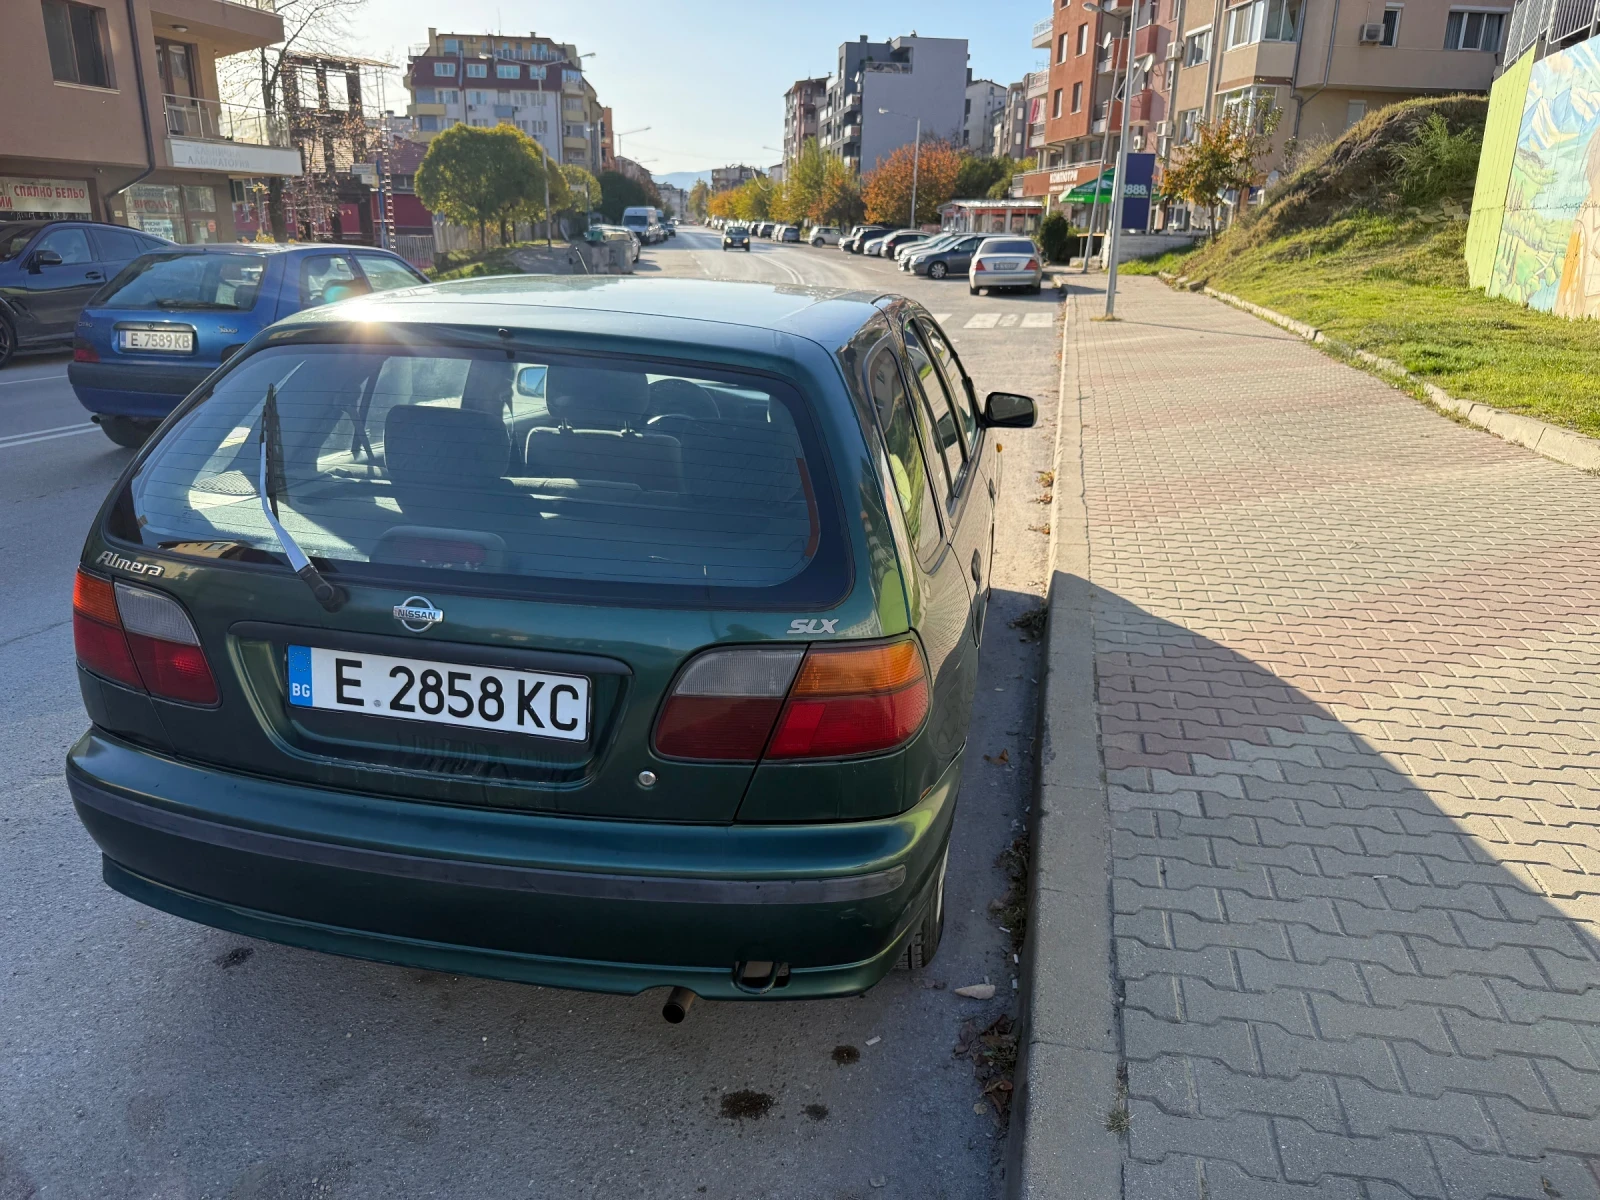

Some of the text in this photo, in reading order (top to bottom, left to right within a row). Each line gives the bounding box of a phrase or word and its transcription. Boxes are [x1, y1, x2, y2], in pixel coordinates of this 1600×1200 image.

[14, 185, 85, 199] СПАЛНО БЕЛЬО
[95, 550, 165, 577] Almera
[397, 609, 436, 620] NISSAN
[786, 618, 840, 634] SLX
[292, 682, 311, 698] BG
[335, 657, 579, 732] E 2858 KC
